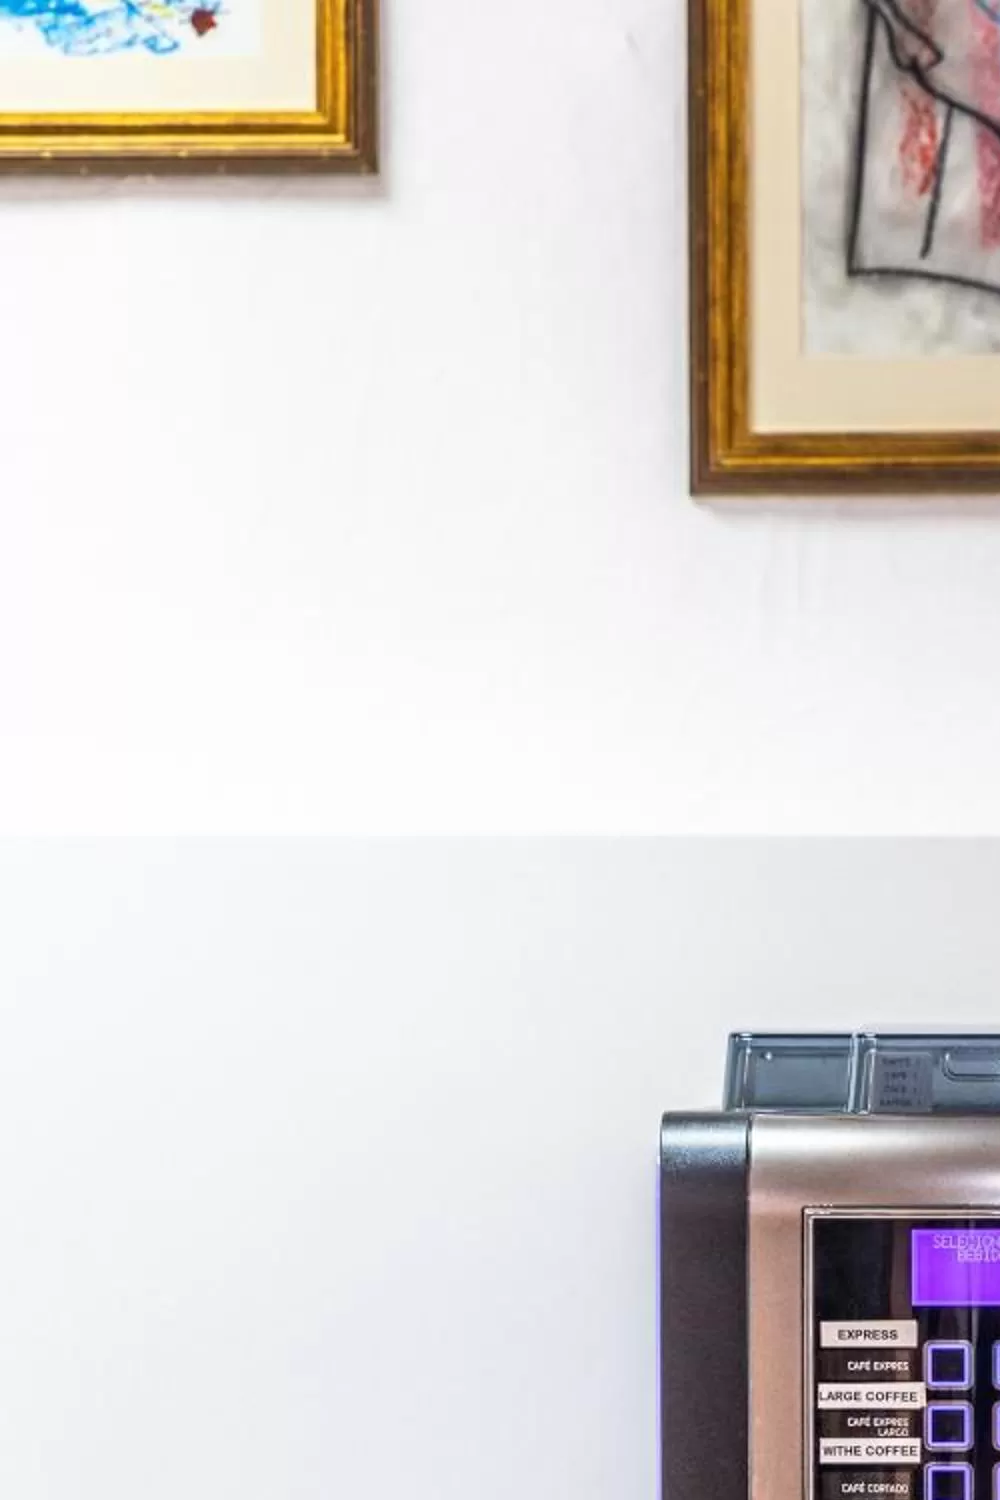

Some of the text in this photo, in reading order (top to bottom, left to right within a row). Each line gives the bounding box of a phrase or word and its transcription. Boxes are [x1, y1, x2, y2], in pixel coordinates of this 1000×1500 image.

[838, 1329, 898, 1340] EXPRESS
[847, 1358, 871, 1371] CAFÉ
[819, 1391, 918, 1402] LARGE COFFEE
[847, 1416, 871, 1427] CAFÉ
[823, 1445, 918, 1457] WITHE COFFEE
[841, 1481, 909, 1493] CAFÉ CORTADO
